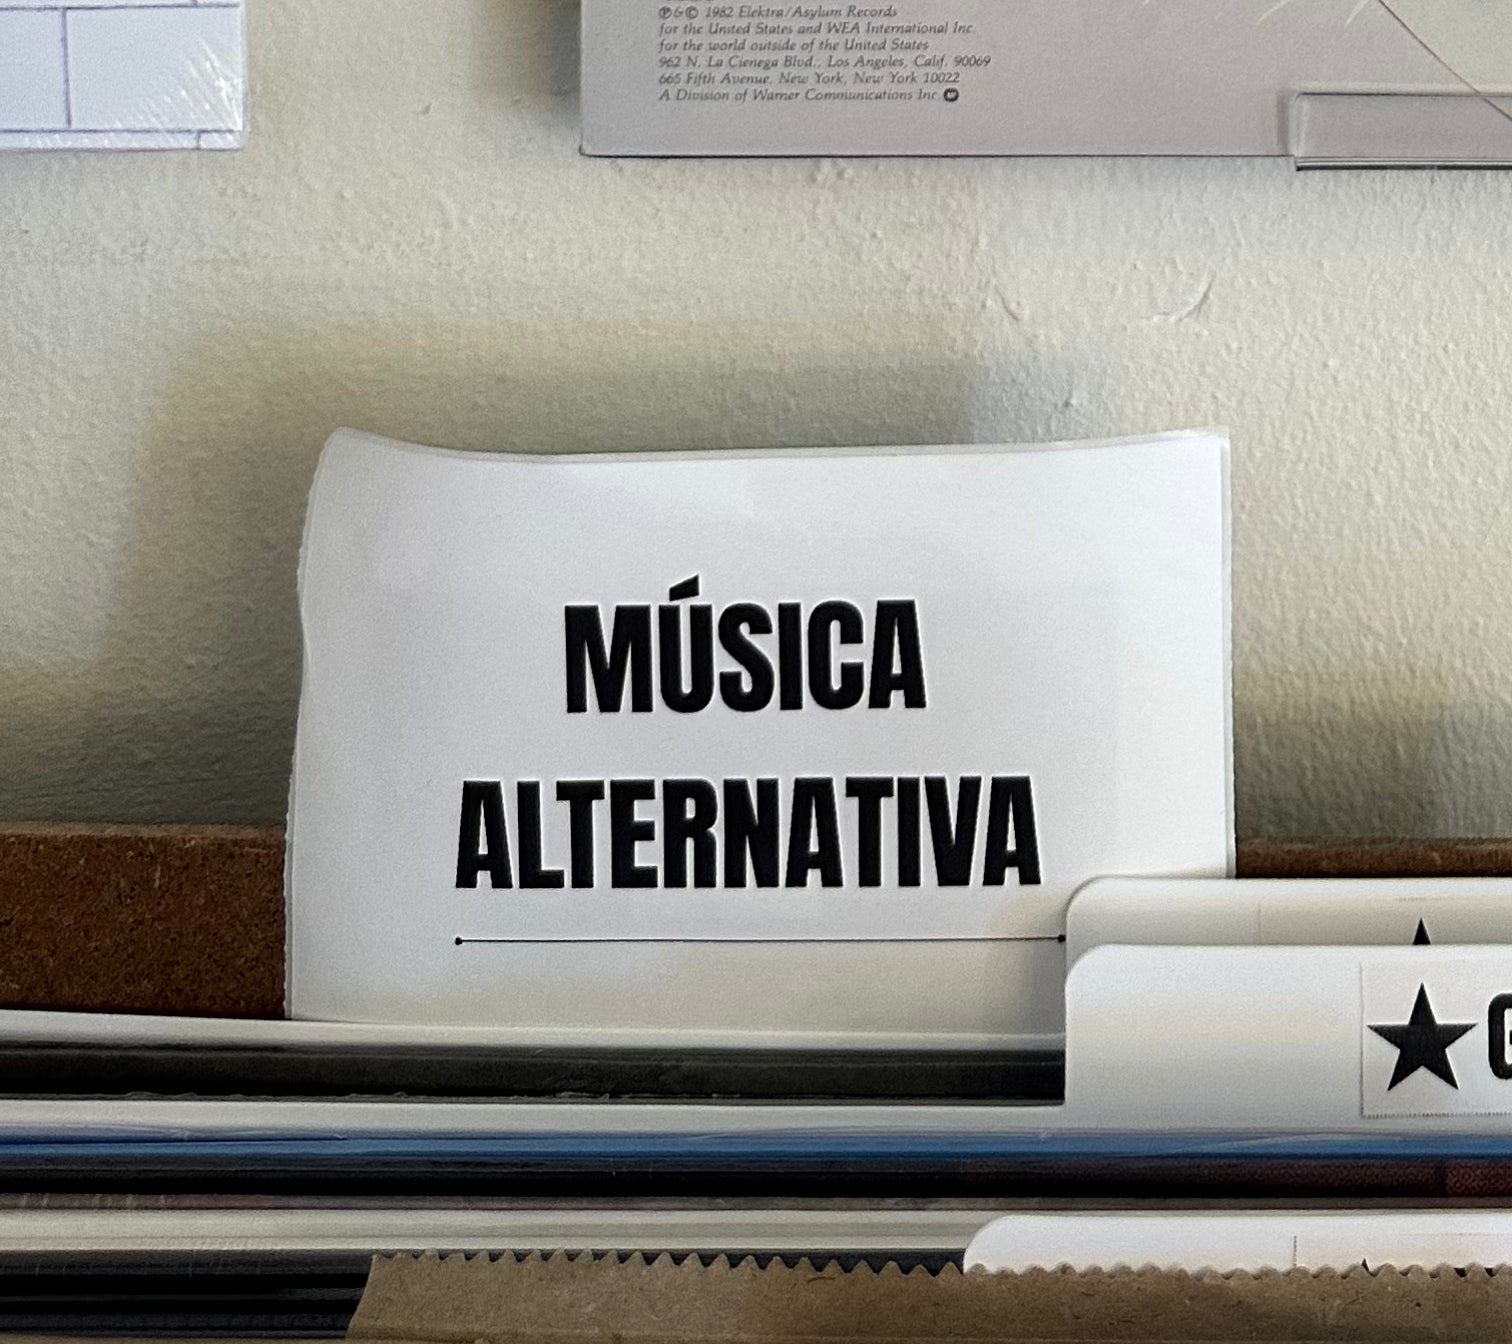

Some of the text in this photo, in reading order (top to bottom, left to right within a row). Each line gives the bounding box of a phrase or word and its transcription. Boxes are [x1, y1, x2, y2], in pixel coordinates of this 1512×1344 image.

[658, 22, 679, 37] for
[682, 21, 703, 35] the
[707, 21, 751, 35] United
[754, 21, 793, 35] States
[796, 21, 822, 35] and
[825, 21, 860, 34] WEA
[865, 21, 948, 35] International
[704, 5, 734, 18] 1982
[845, 4, 897, 18] Records
[564, 574, 928, 714] MÚSICA
[455, 775, 1042, 890] ALTERNATIVA
